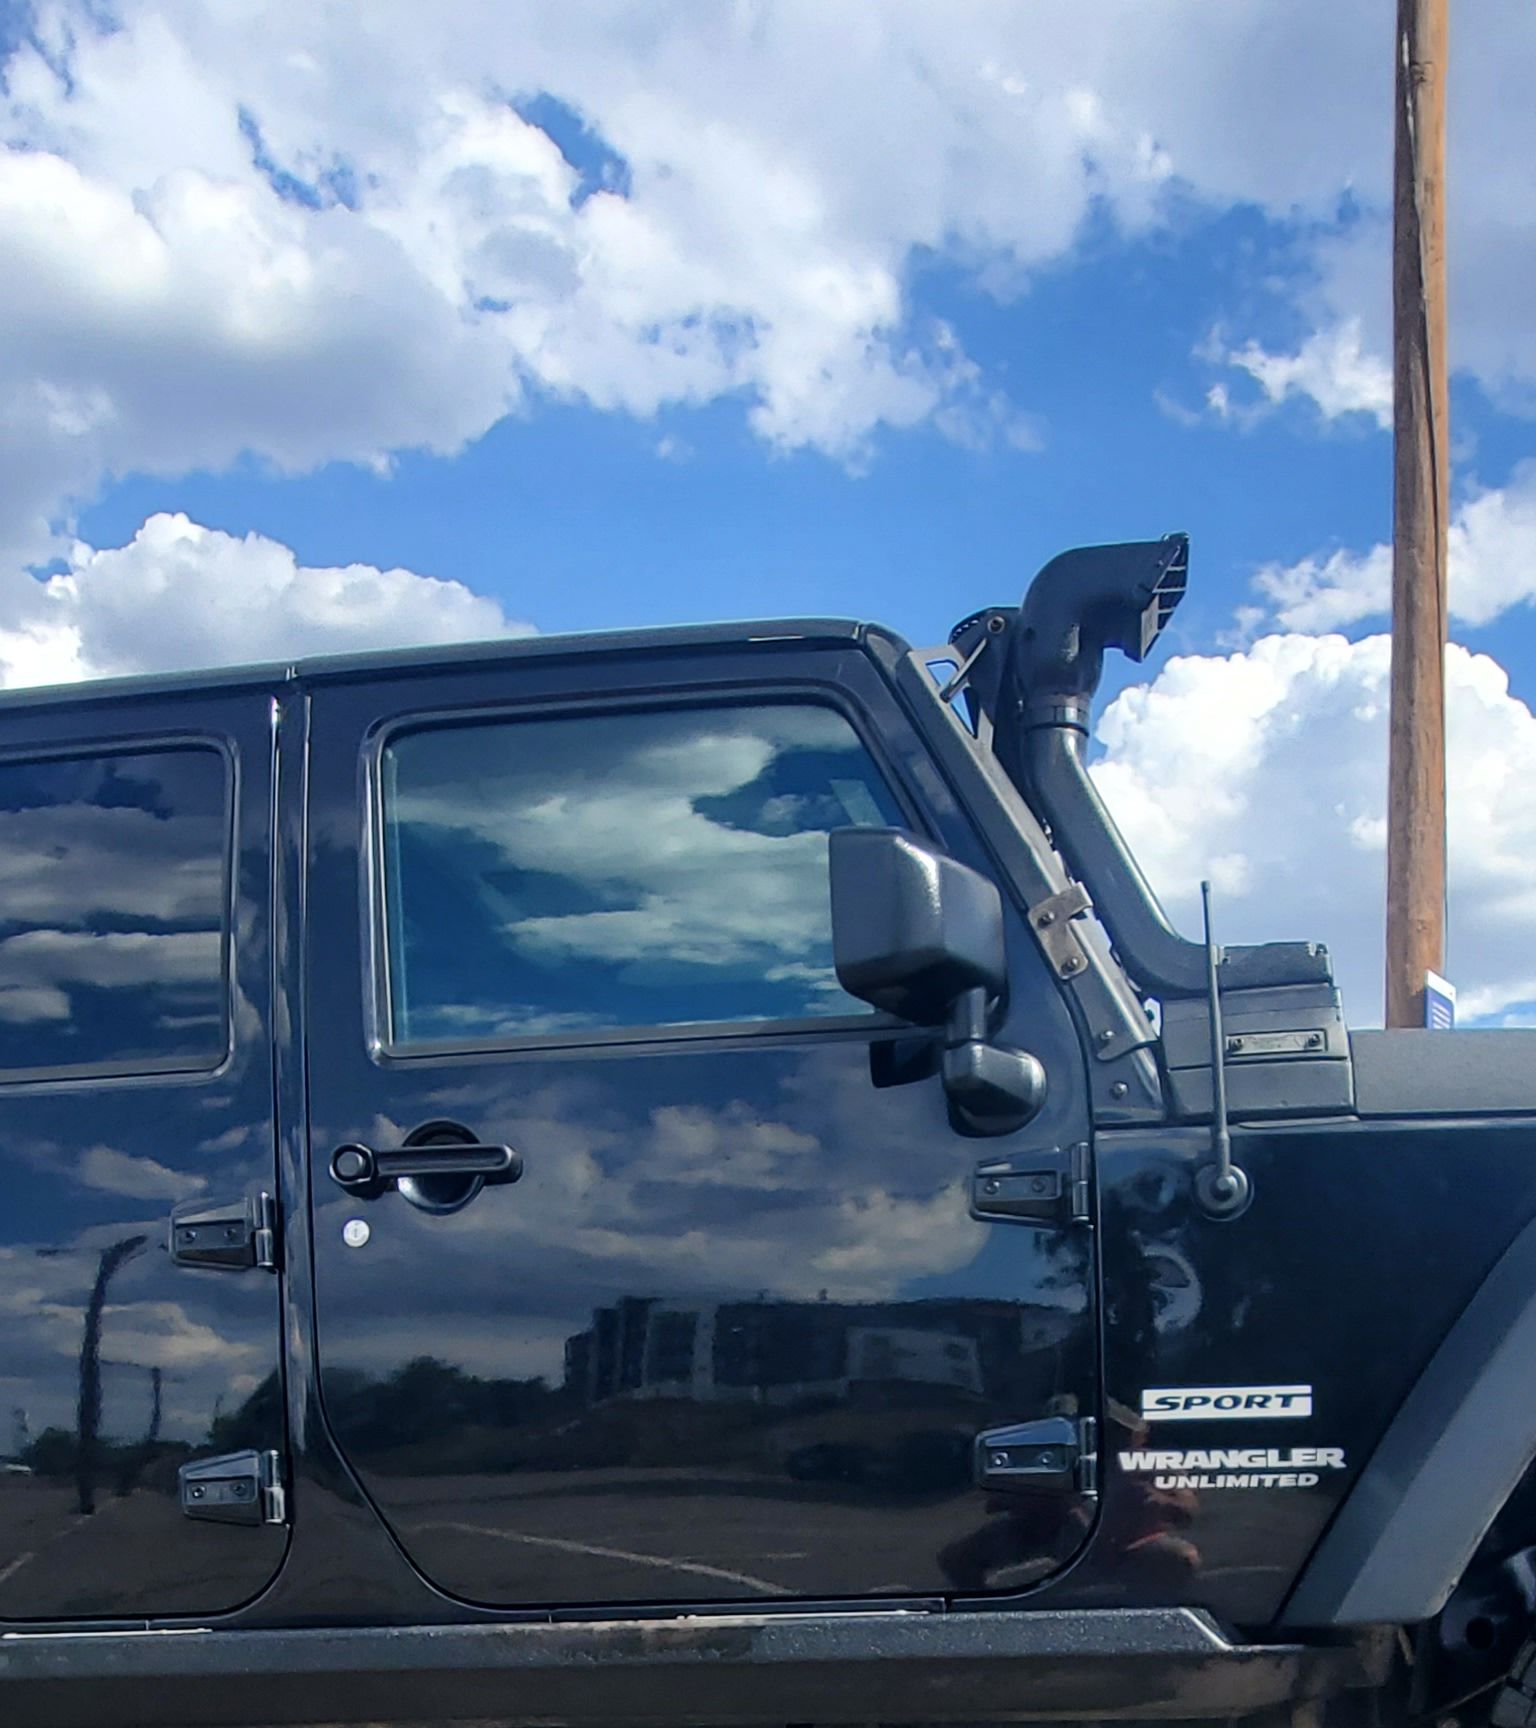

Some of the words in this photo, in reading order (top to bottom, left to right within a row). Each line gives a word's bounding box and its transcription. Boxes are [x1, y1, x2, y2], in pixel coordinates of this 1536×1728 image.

[1143, 1392, 1312, 1412] SPORT
[1118, 1448, 1347, 1470] WRANGLER
[1154, 1473, 1319, 1489] UNLIMITED
